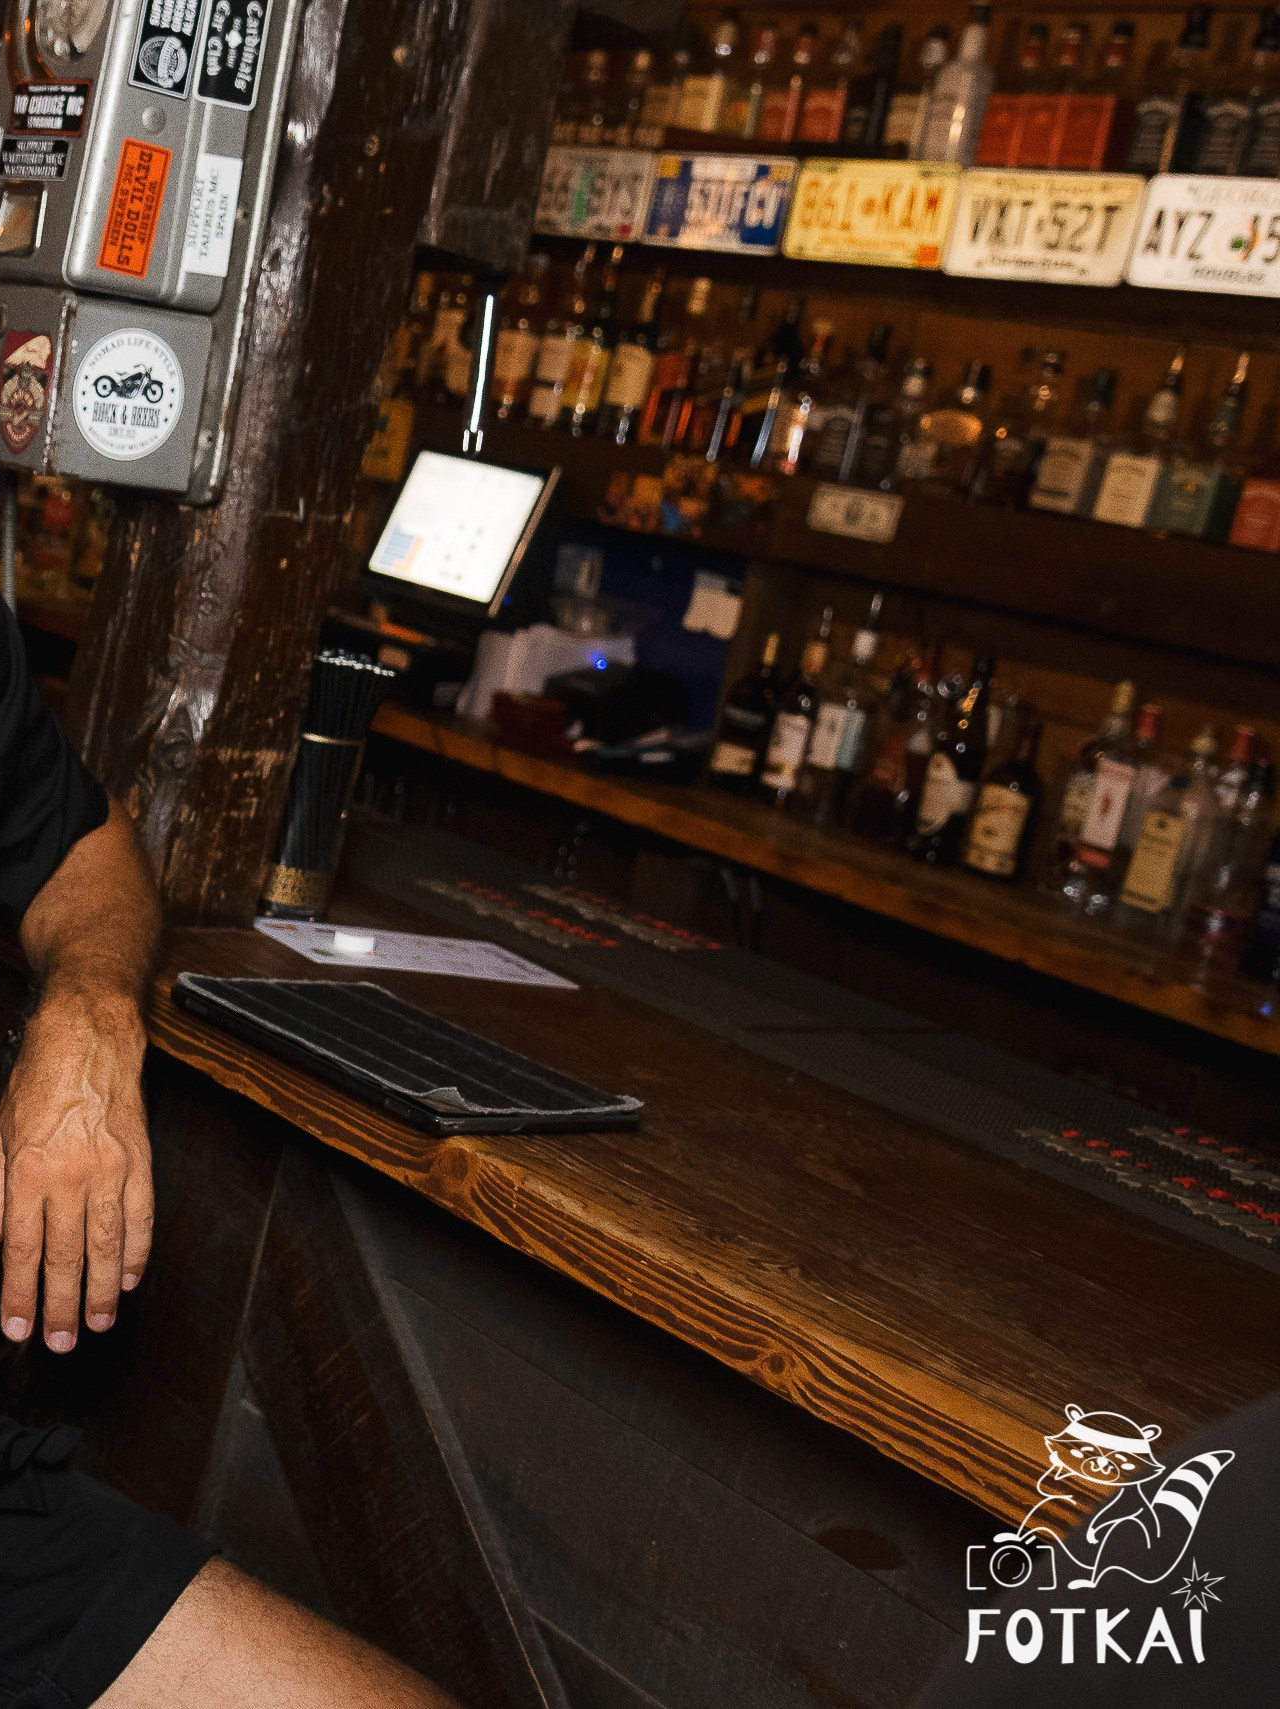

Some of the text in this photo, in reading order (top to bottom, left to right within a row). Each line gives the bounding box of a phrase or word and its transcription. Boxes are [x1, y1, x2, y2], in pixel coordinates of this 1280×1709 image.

[234, 0, 263, 93] Cardinals
[117, 150, 153, 266] DEVIL DOLLS
[187, 179, 205, 248] SUPPORT
[199, 198, 216, 257] TAURUS
[1141, 207, 1215, 260] AYZ
[89, 339, 125, 370] NOMAD
[92, 401, 119, 424] ROCK
[120, 405, 128, 425] &
